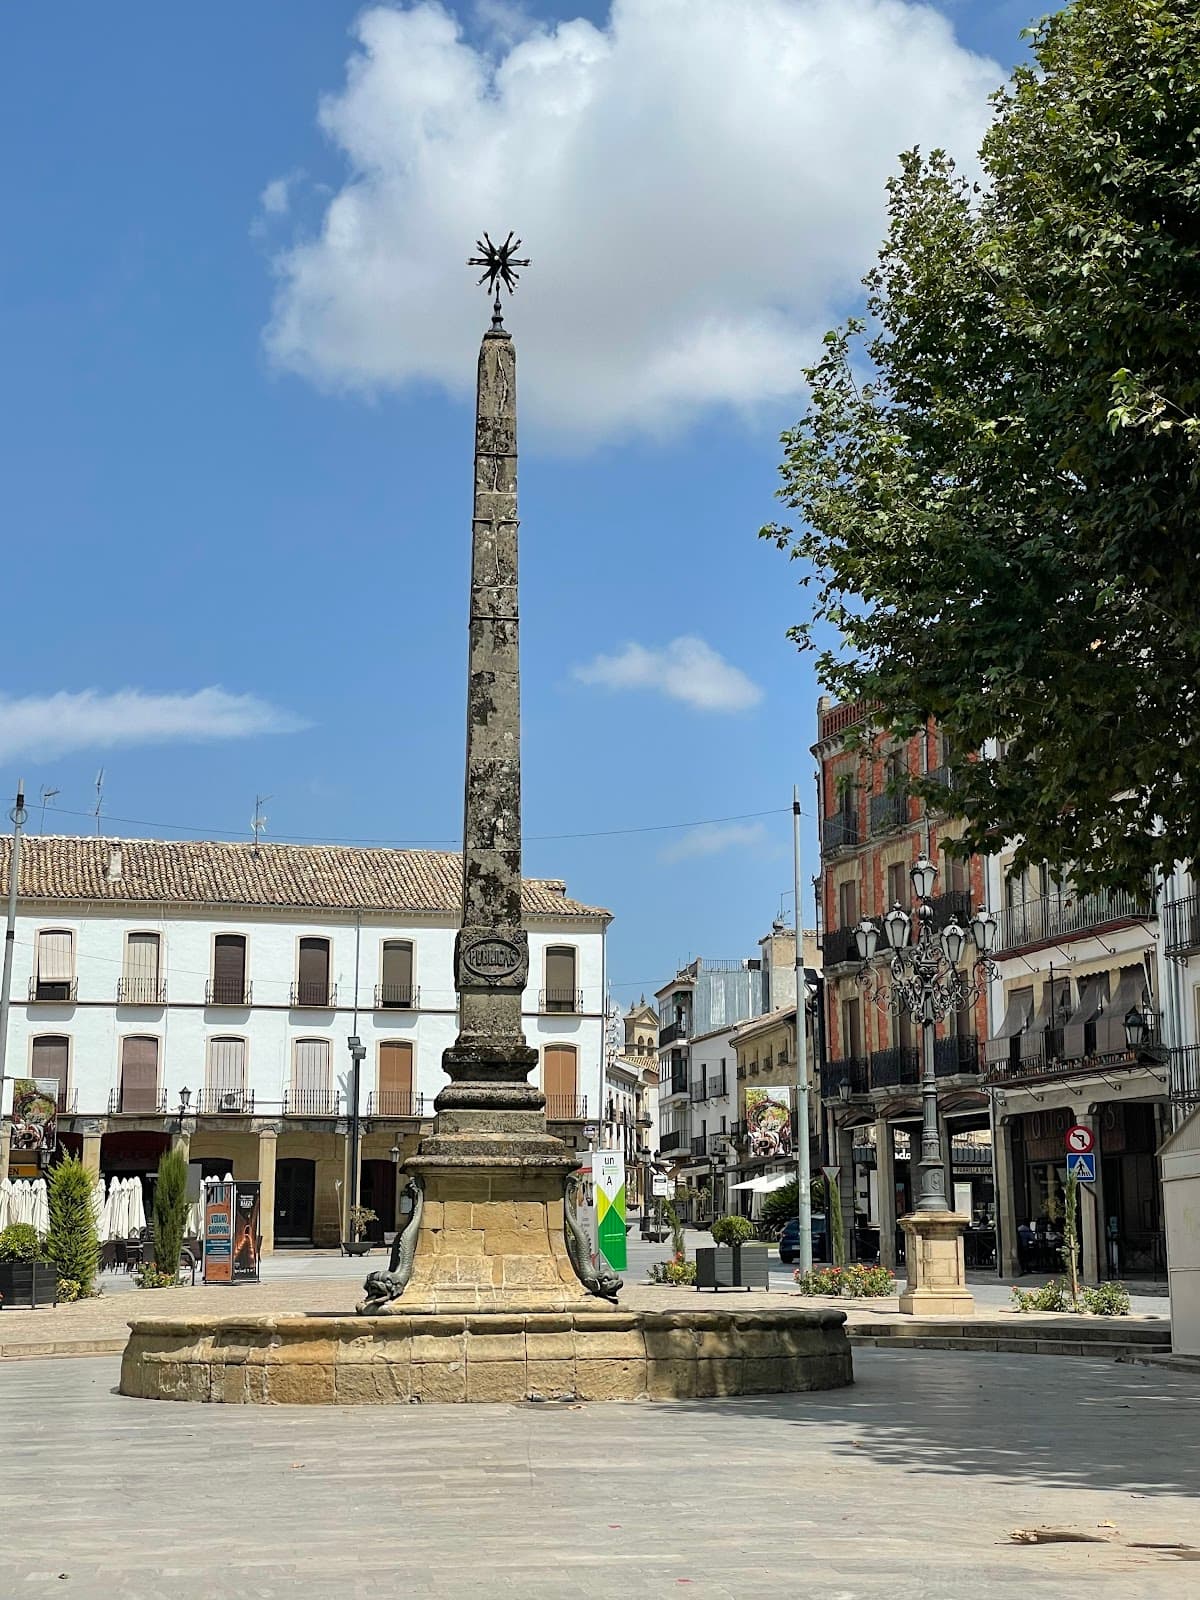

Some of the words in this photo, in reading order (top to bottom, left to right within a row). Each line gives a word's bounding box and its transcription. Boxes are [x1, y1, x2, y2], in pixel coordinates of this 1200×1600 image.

[469, 948, 517, 967] PUBLICAS
[604, 1157, 615, 1165] un
[606, 1175, 613, 1186] A
[211, 1214, 227, 1223] VERANO
[208, 1225, 230, 1235] SHOPPING
